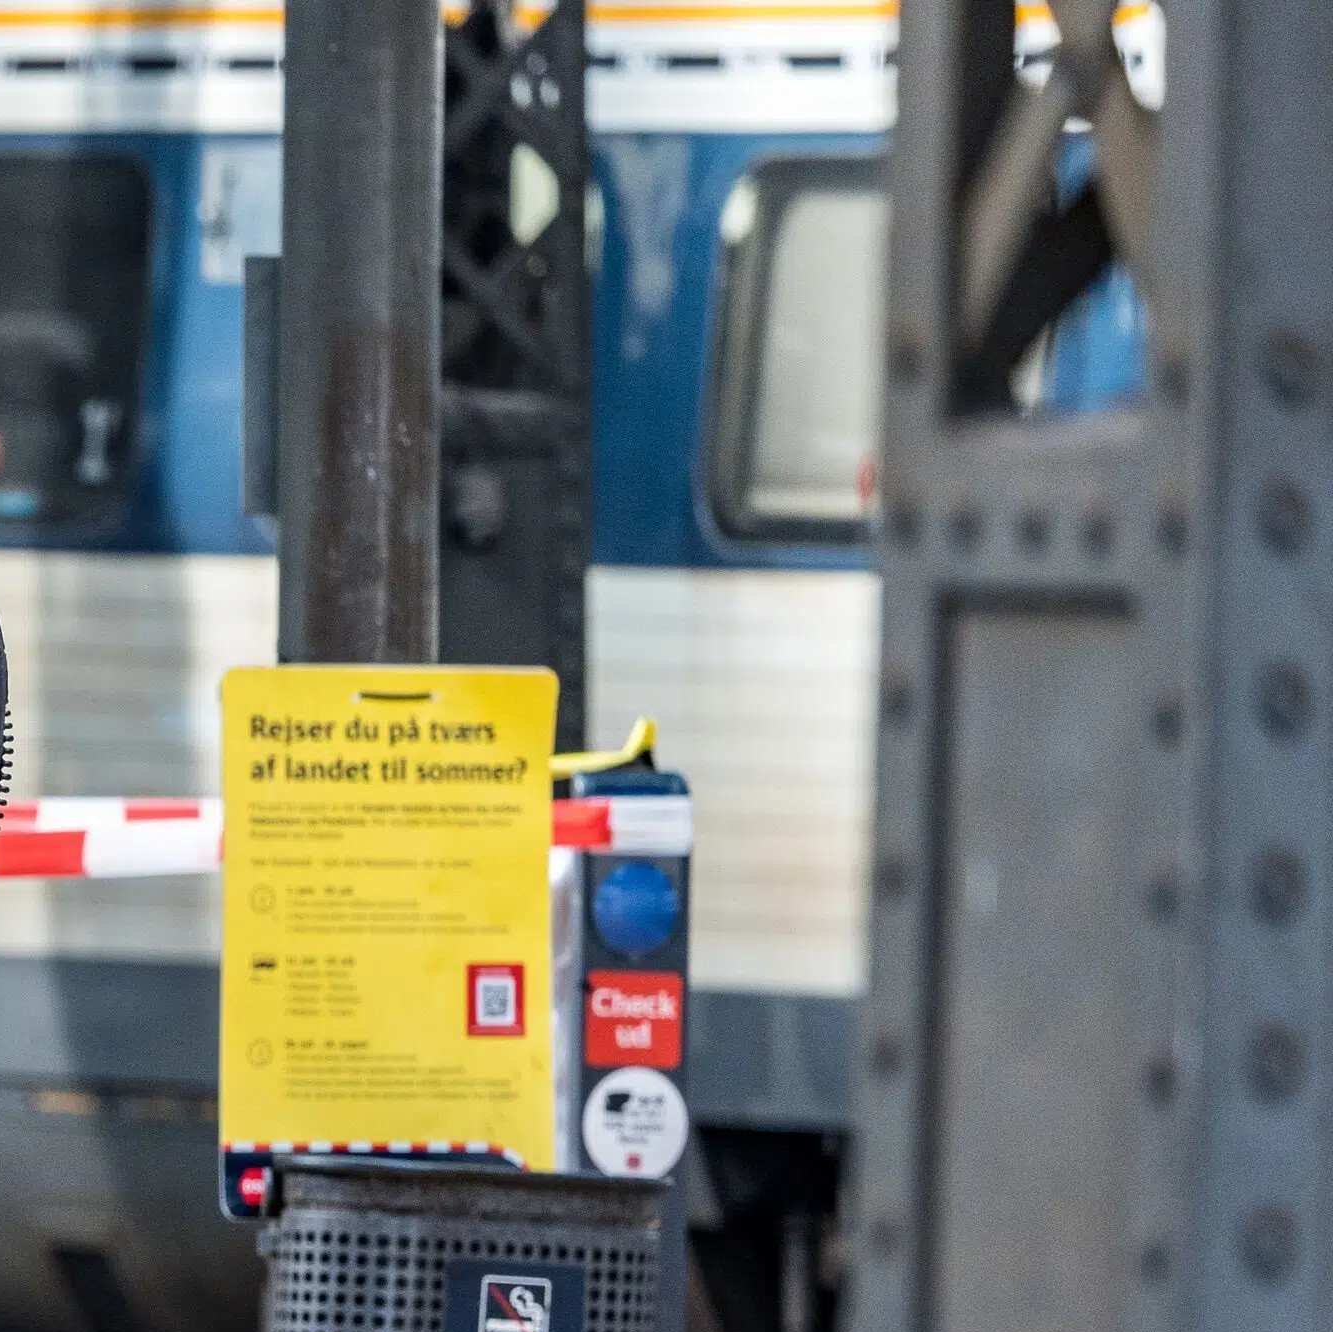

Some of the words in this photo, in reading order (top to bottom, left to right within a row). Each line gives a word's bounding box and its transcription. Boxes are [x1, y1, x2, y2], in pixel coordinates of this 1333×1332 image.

[250, 714, 334, 745] Rejser
[345, 716, 379, 742] du
[388, 716, 421, 747] på
[429, 719, 497, 742] tværs
[251, 754, 277, 780] af
[285, 754, 370, 782] landet
[381, 757, 408, 782] til
[417, 757, 529, 784] sommer?
[591, 987, 677, 1020] Check
[614, 1019, 652, 1049] ud
